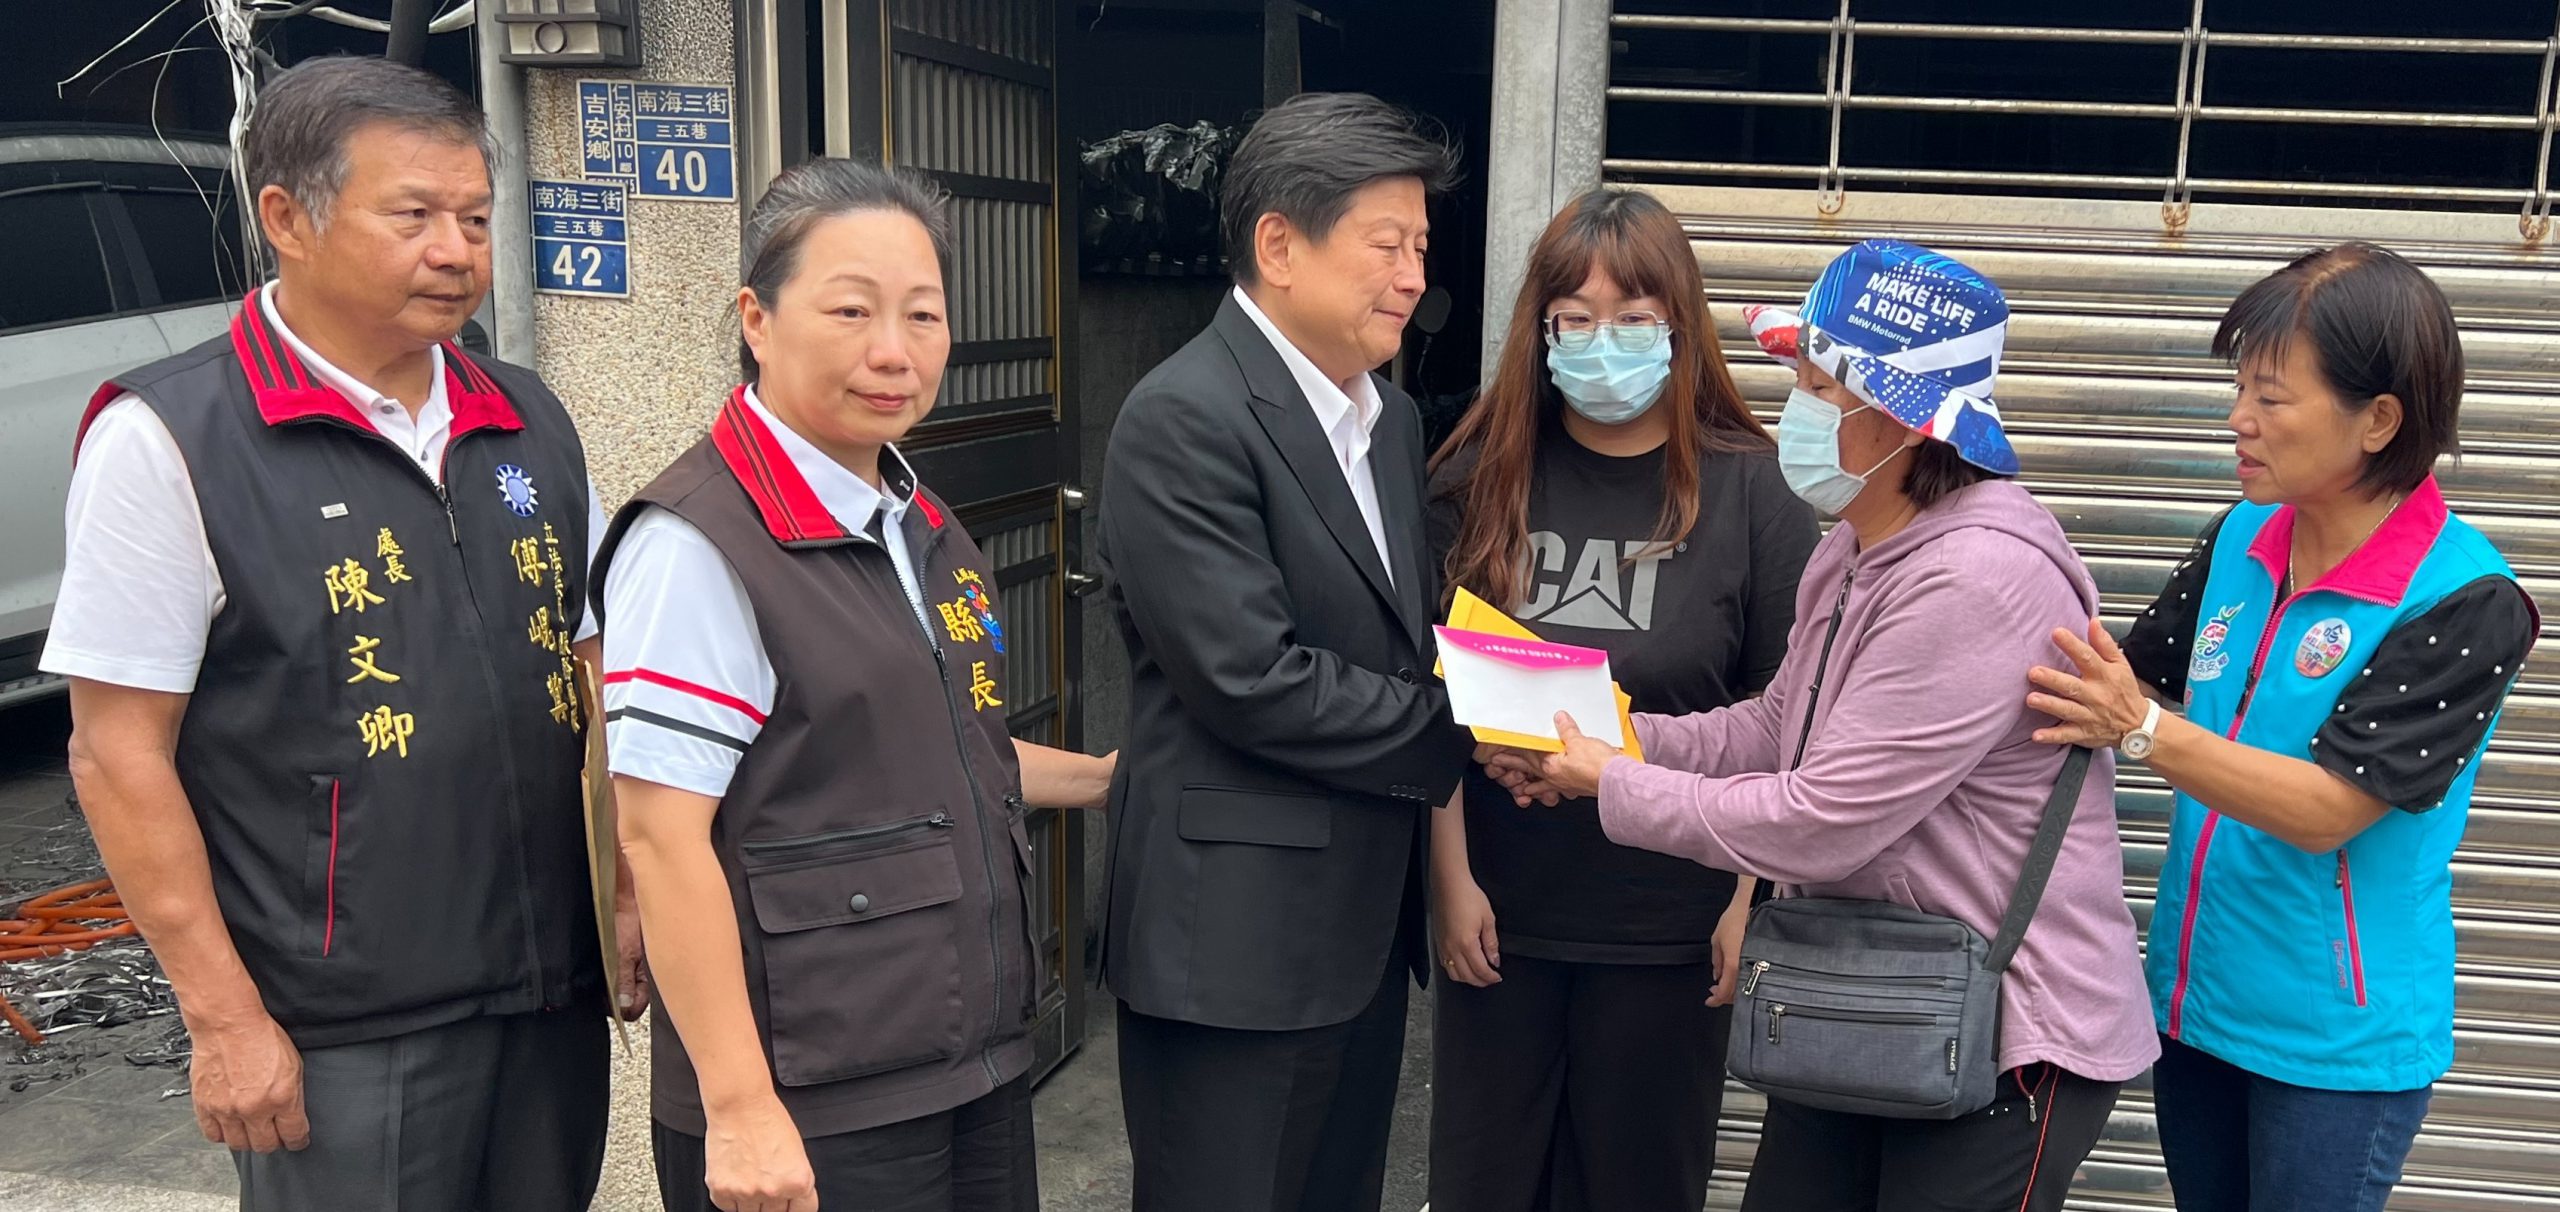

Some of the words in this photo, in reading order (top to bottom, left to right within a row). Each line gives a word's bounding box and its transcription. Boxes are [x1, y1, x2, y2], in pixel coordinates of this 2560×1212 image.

[612, 84, 633, 139] 仁安村
[637, 90, 728, 115] 南海三街
[583, 94, 611, 161] 吉安鄉
[655, 123, 708, 140] 三五巷
[655, 149, 708, 193] 40
[534, 186, 622, 213] 南海三街
[553, 219, 604, 237] 三五巷
[552, 245, 603, 287] 42
[1854, 293, 1873, 312] A
[1873, 300, 1929, 334] RIDE
[1866, 272, 1930, 309] MAKE
[1930, 295, 1976, 329] LIFE
[1847, 314, 1870, 329] BMW
[1870, 323, 1913, 345] Motorrad
[377, 527, 412, 584] 處長
[1513, 530, 1674, 631] CAT
[324, 558, 414, 758] 陳文卿
[936, 596, 1003, 713] 縣長
